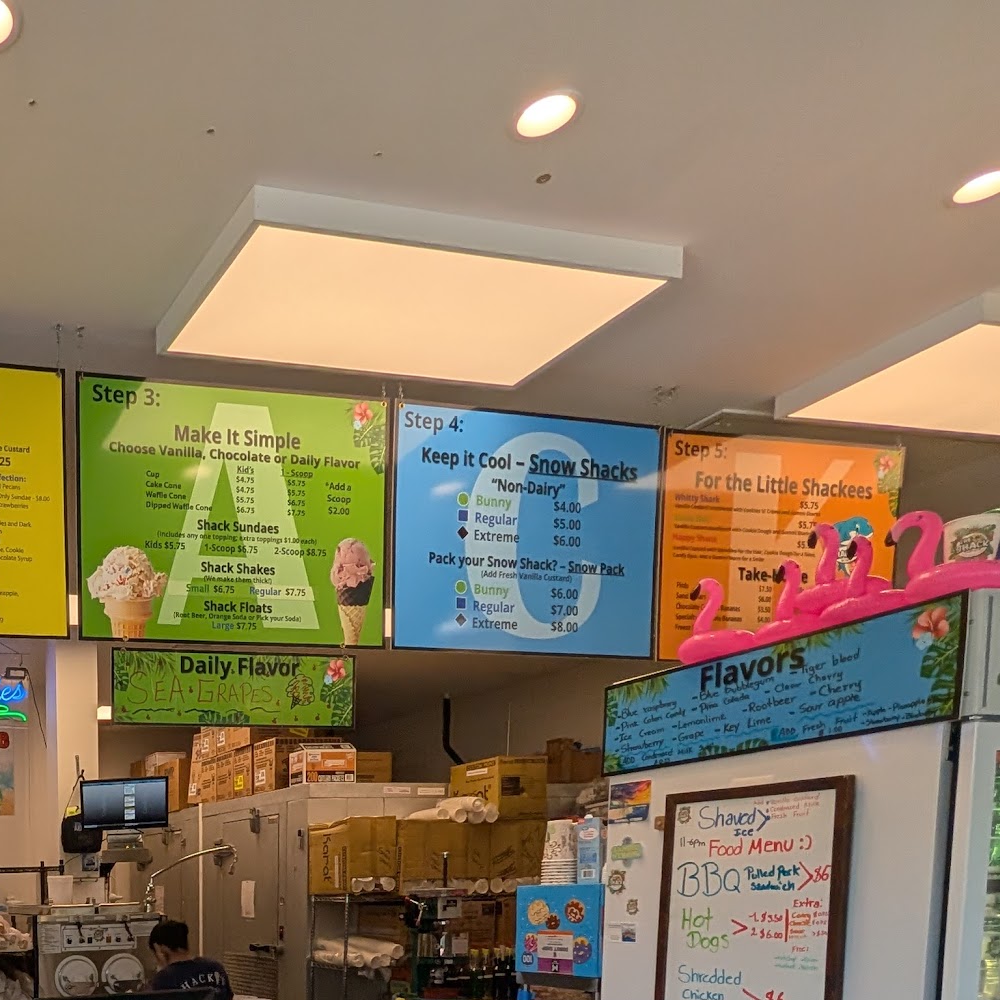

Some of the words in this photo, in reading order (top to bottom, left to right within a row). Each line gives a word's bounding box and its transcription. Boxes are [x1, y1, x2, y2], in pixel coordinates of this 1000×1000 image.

[92, 384, 138, 410] Step
[143, 388, 160, 407] 3:
[404, 411, 444, 434] Step
[448, 416, 464, 433] 4:
[174, 424, 222, 444] Make
[226, 428, 239, 445] It
[244, 429, 301, 453] Simple
[109, 441, 156, 455] Choose
[158, 444, 206, 460] Vanilla,
[210, 448, 271, 463] Chocolate
[291, 454, 321, 469] Daily
[324, 456, 360, 470] Flavor
[674, 440, 710, 461] Step
[714, 442, 727, 460] 5:
[421, 446, 461, 470] Keep
[463, 450, 475, 468] it
[478, 451, 512, 470] Cool
[528, 453, 577, 476] Snow
[580, 458, 638, 482] Shacks
[695, 471, 723, 489] For
[726, 472, 753, 491] the
[756, 474, 798, 494] Little
[801, 478, 873, 500] Shackees
[328, 506, 350, 515] $2.00
[476, 495, 512, 511] Bunny
[553, 501, 581, 514] $4.00
[799, 501, 819, 510] $5.75
[197, 519, 231, 532] Shack
[233, 520, 280, 535] Sundaes
[474, 512, 518, 527] Regular
[553, 518, 581, 531] $5.00
[474, 529, 520, 544] Extreme
[553, 535, 581, 548] $6.00
[145, 540, 162, 550] Kids
[164, 541, 186, 550] $5.75
[204, 543, 236, 555] 1-Scoop
[237, 544, 259, 554] $6.75
[274, 547, 305, 558] 2-Scoop
[306, 548, 327, 557] $8.75
[200, 561, 234, 574] Shack
[236, 562, 276, 576] Shakes
[428, 552, 456, 565] Pack
[458, 555, 485, 569] your
[487, 556, 518, 569] Snow
[519, 557, 558, 571] Shack?
[567, 560, 597, 575] Snow
[600, 563, 625, 577] Pack
[186, 583, 210, 593] Small
[213, 585, 235, 594] $6.75
[249, 586, 282, 598] Regular
[285, 587, 306, 597] $7.75
[203, 600, 237, 613] Shack
[239, 601, 273, 614] Floats
[473, 600, 515, 615] Regular
[551, 604, 579, 616] $7.00
[212, 621, 235, 631] Large
[236, 621, 257, 631] $7.75
[180, 656, 232, 680] Daily
[238, 656, 300, 677] Flavor
[699, 647, 806, 691] Flavors
[127, 670, 185, 704] SEA
[198, 678, 273, 703] GRAPES
[698, 805, 757, 830] Shaved
[709, 837, 743, 858] Food
[676, 861, 741, 898] BBQ
[743, 865, 775, 880] Pulled
[681, 907, 714, 931] Hot
[686, 930, 730, 954] Dogs
[677, 964, 742, 986] Shredded
